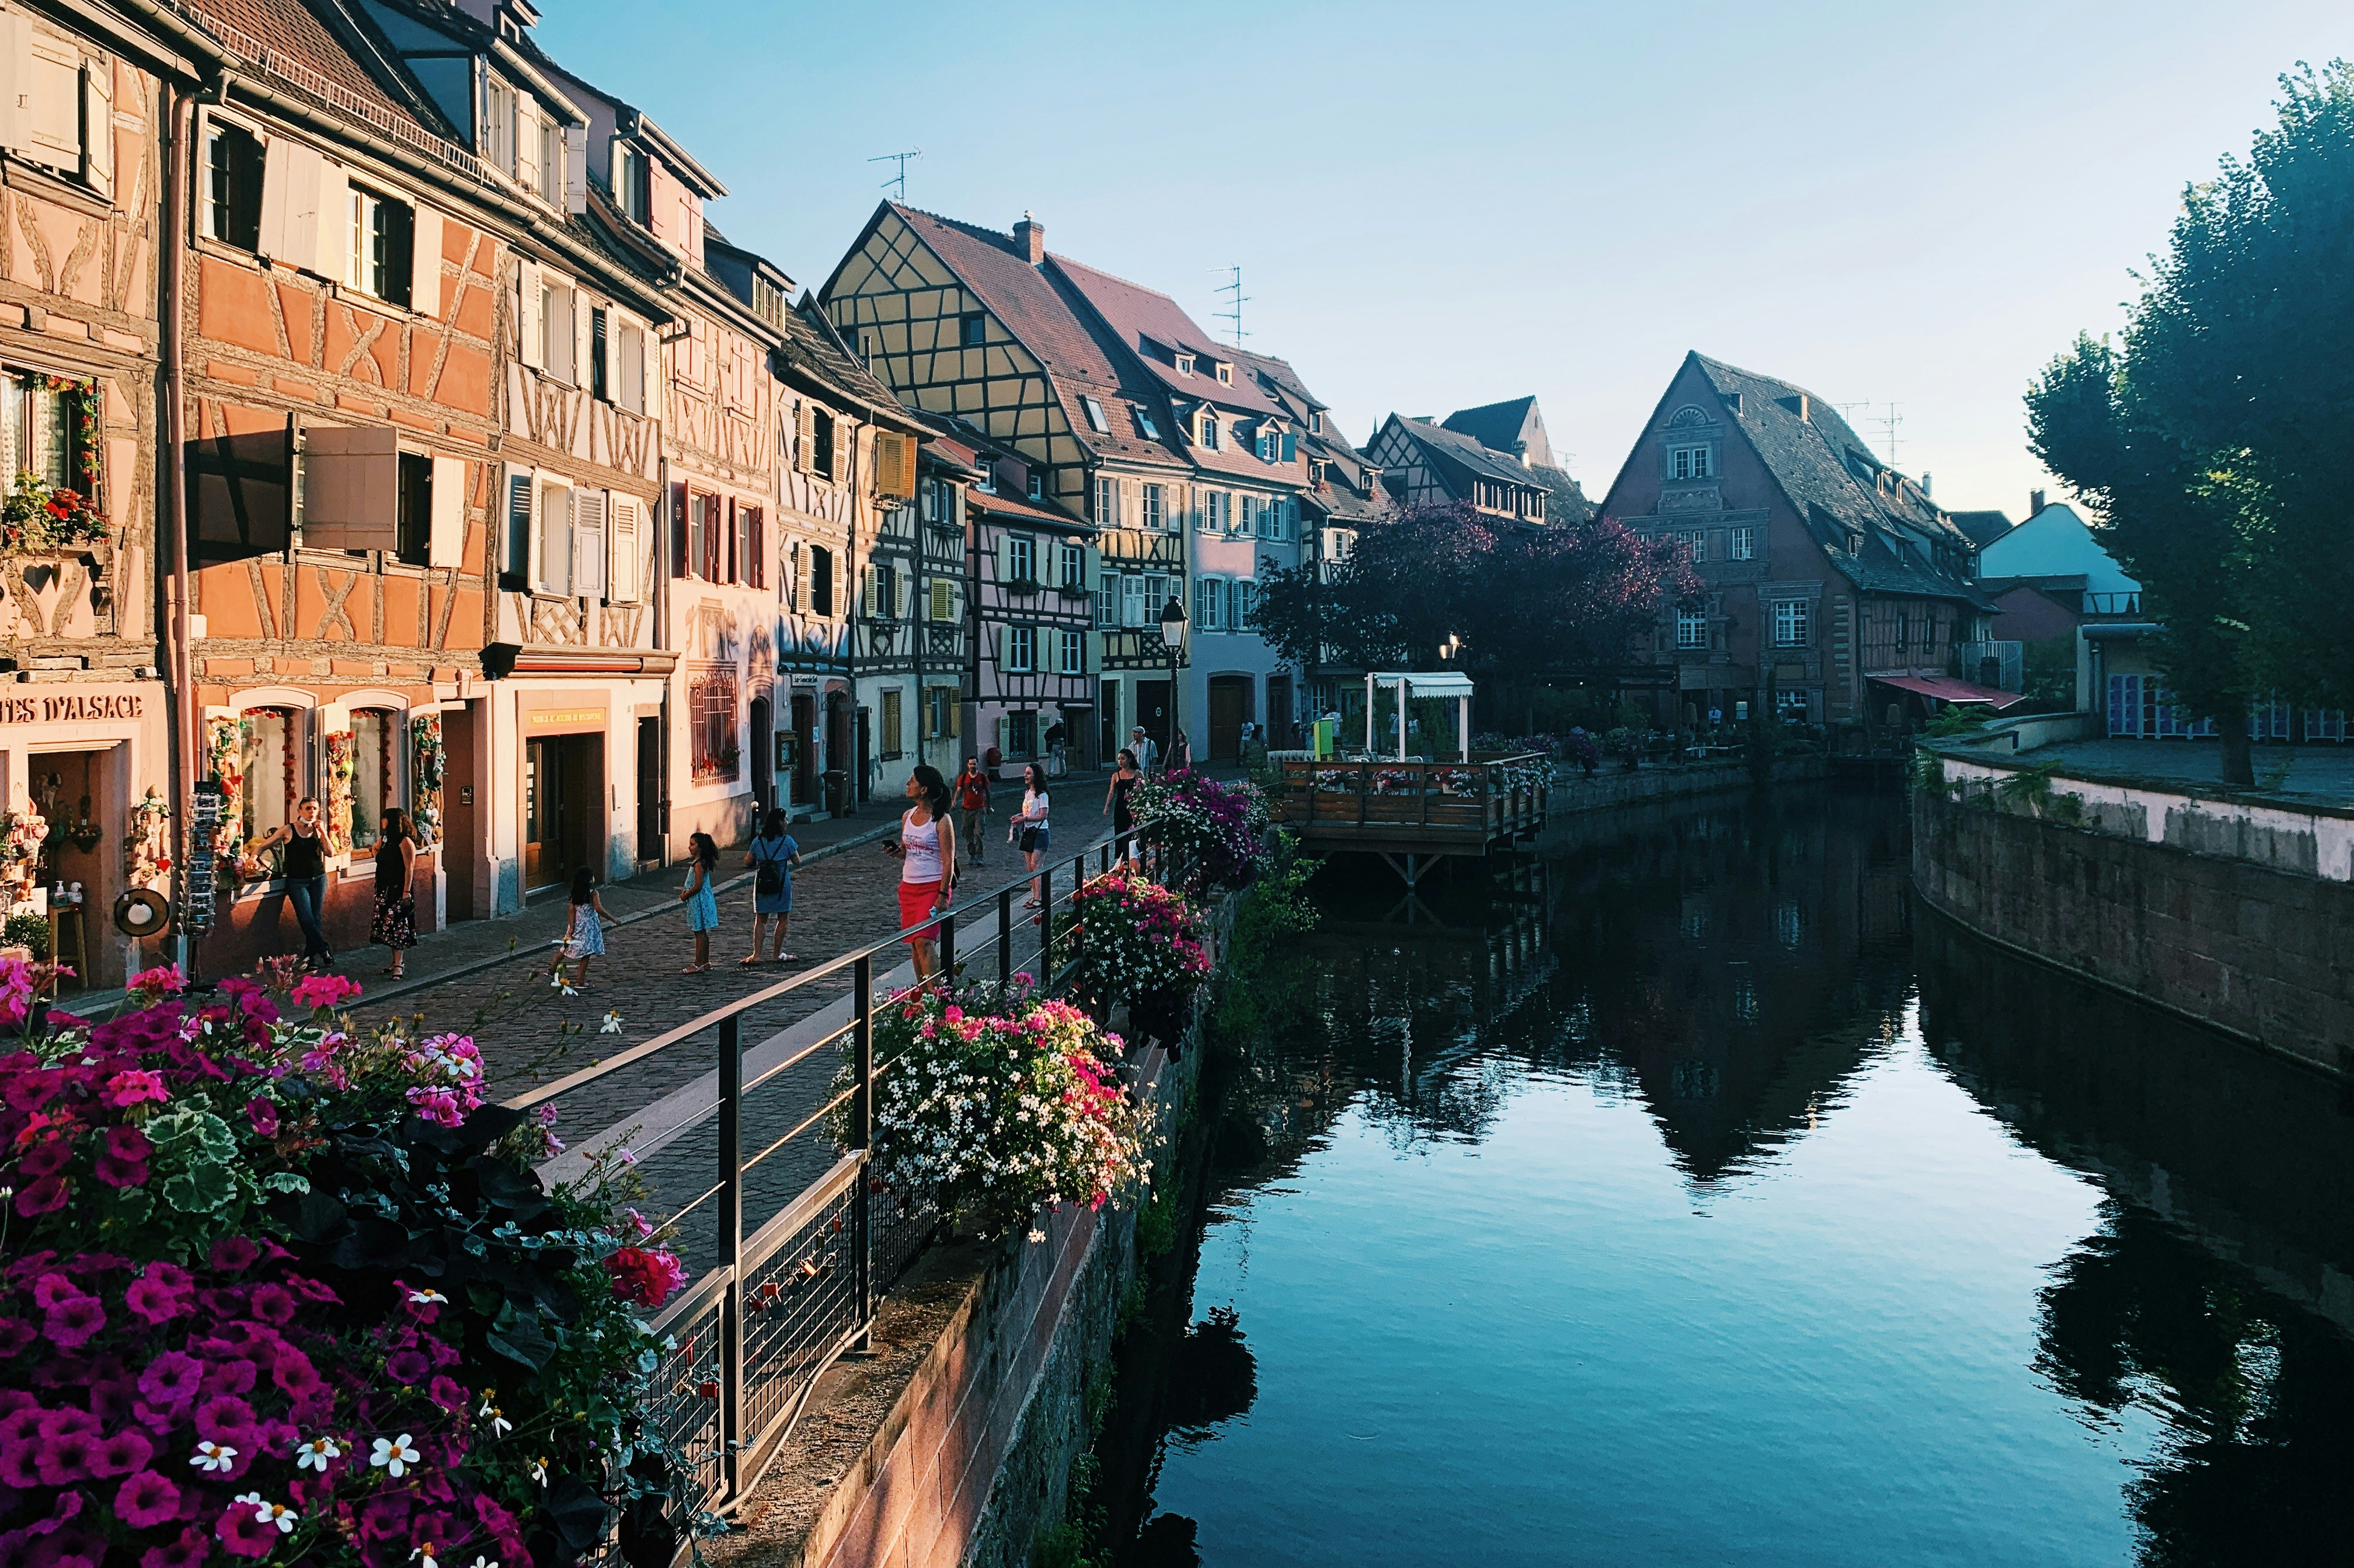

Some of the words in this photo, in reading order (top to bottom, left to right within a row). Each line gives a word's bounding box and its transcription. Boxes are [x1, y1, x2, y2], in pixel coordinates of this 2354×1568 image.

[42, 695, 142, 722] D'ALSACE
[532, 715, 549, 723] MAISN
[549, 714, 572, 723] ALACIENNE
